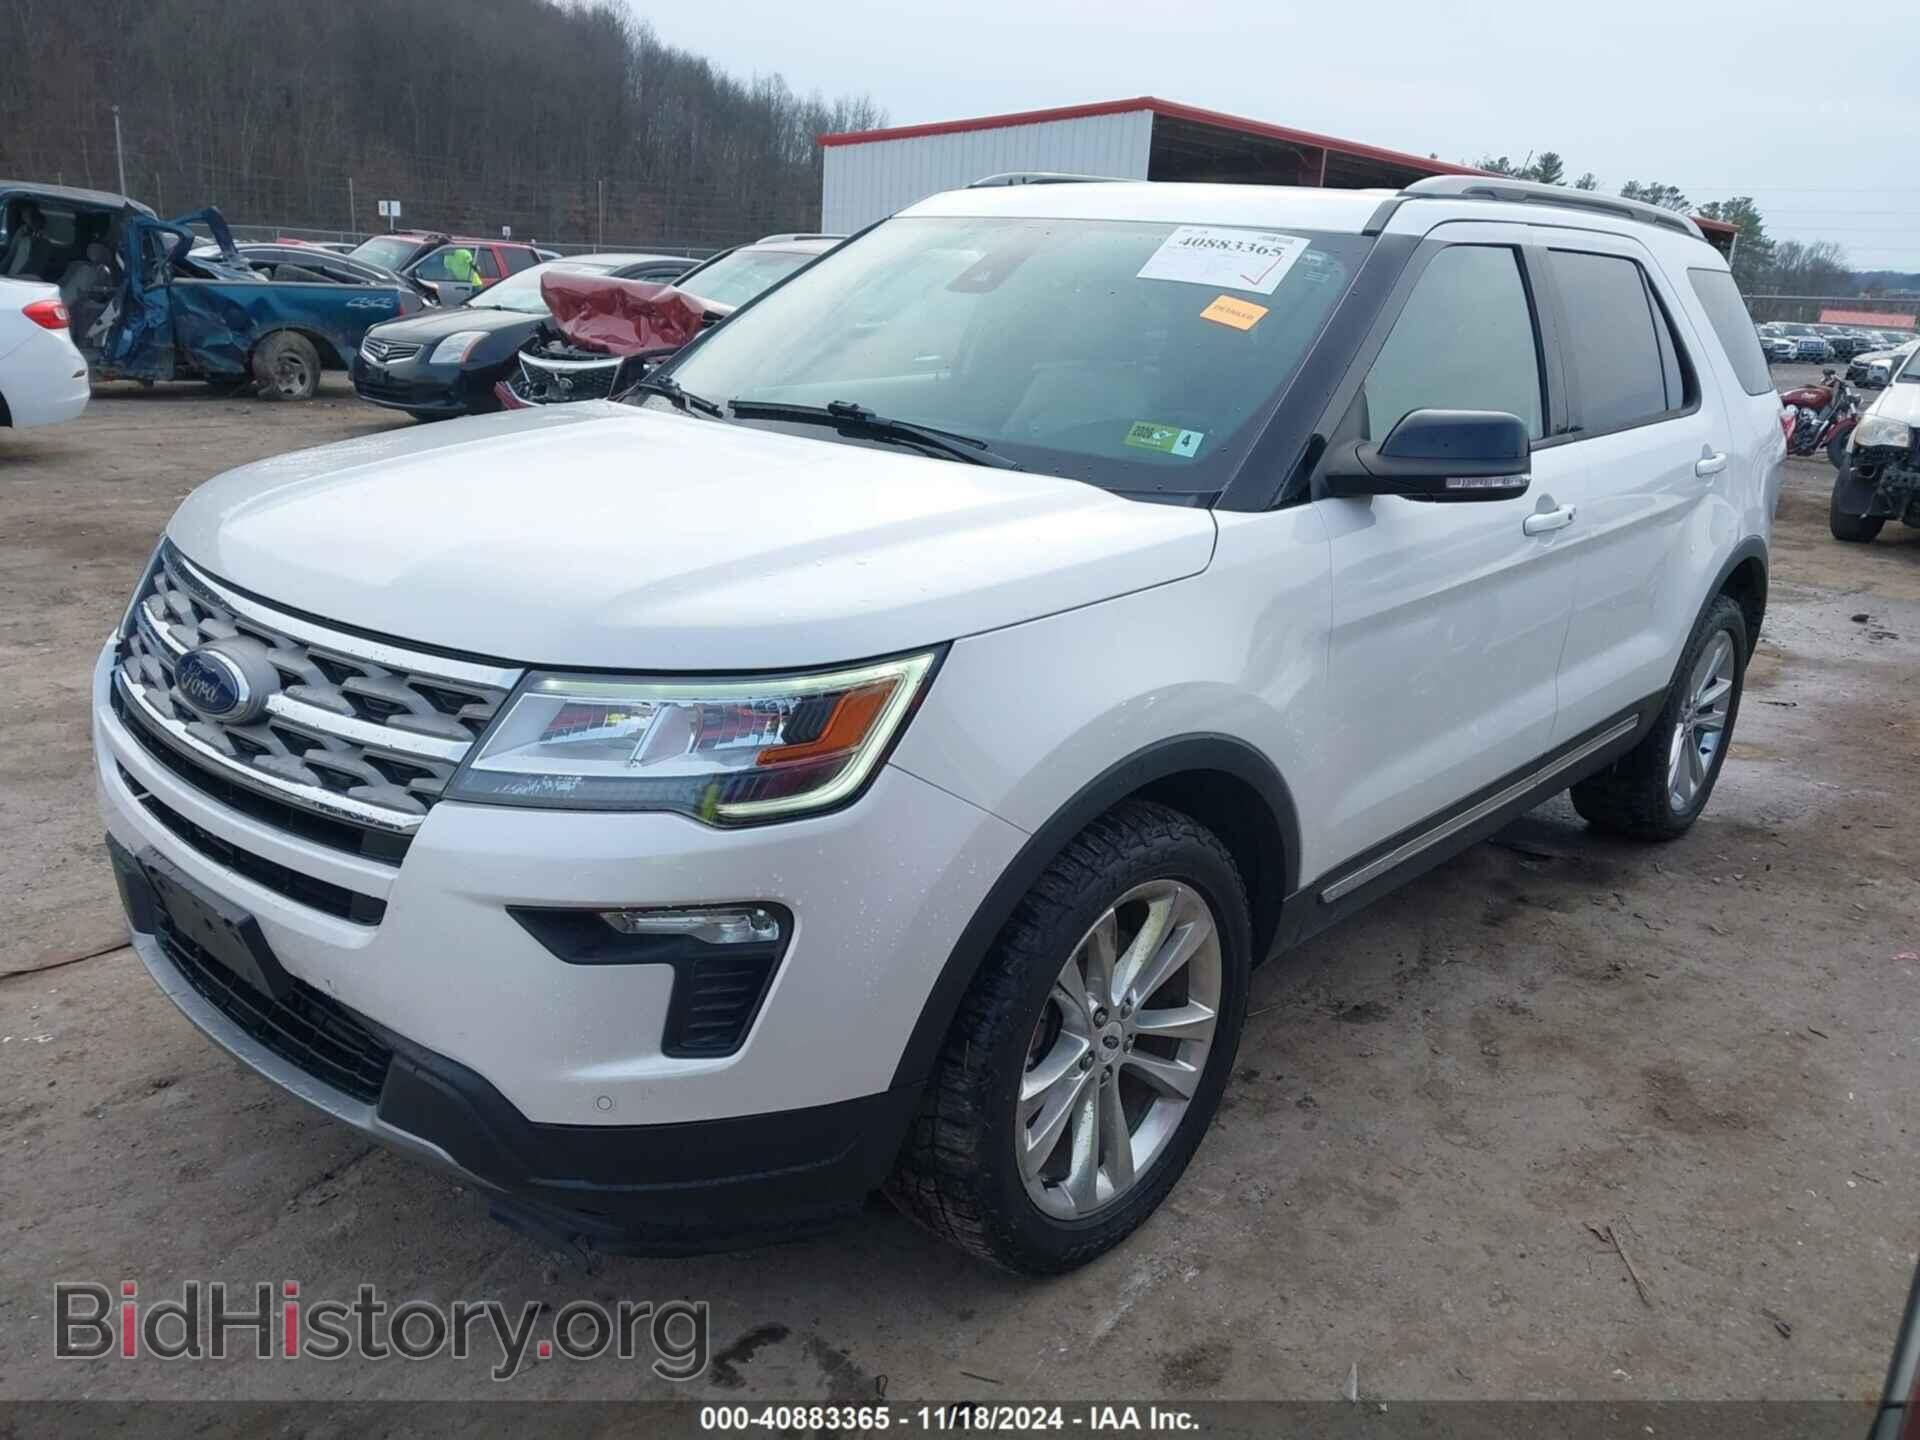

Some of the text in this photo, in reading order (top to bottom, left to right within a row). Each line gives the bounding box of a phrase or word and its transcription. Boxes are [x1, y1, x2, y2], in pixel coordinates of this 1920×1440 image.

[1178, 235, 1286, 257] 40883365
[1181, 433, 1192, 448] 4
[180, 659, 220, 703] Ford
